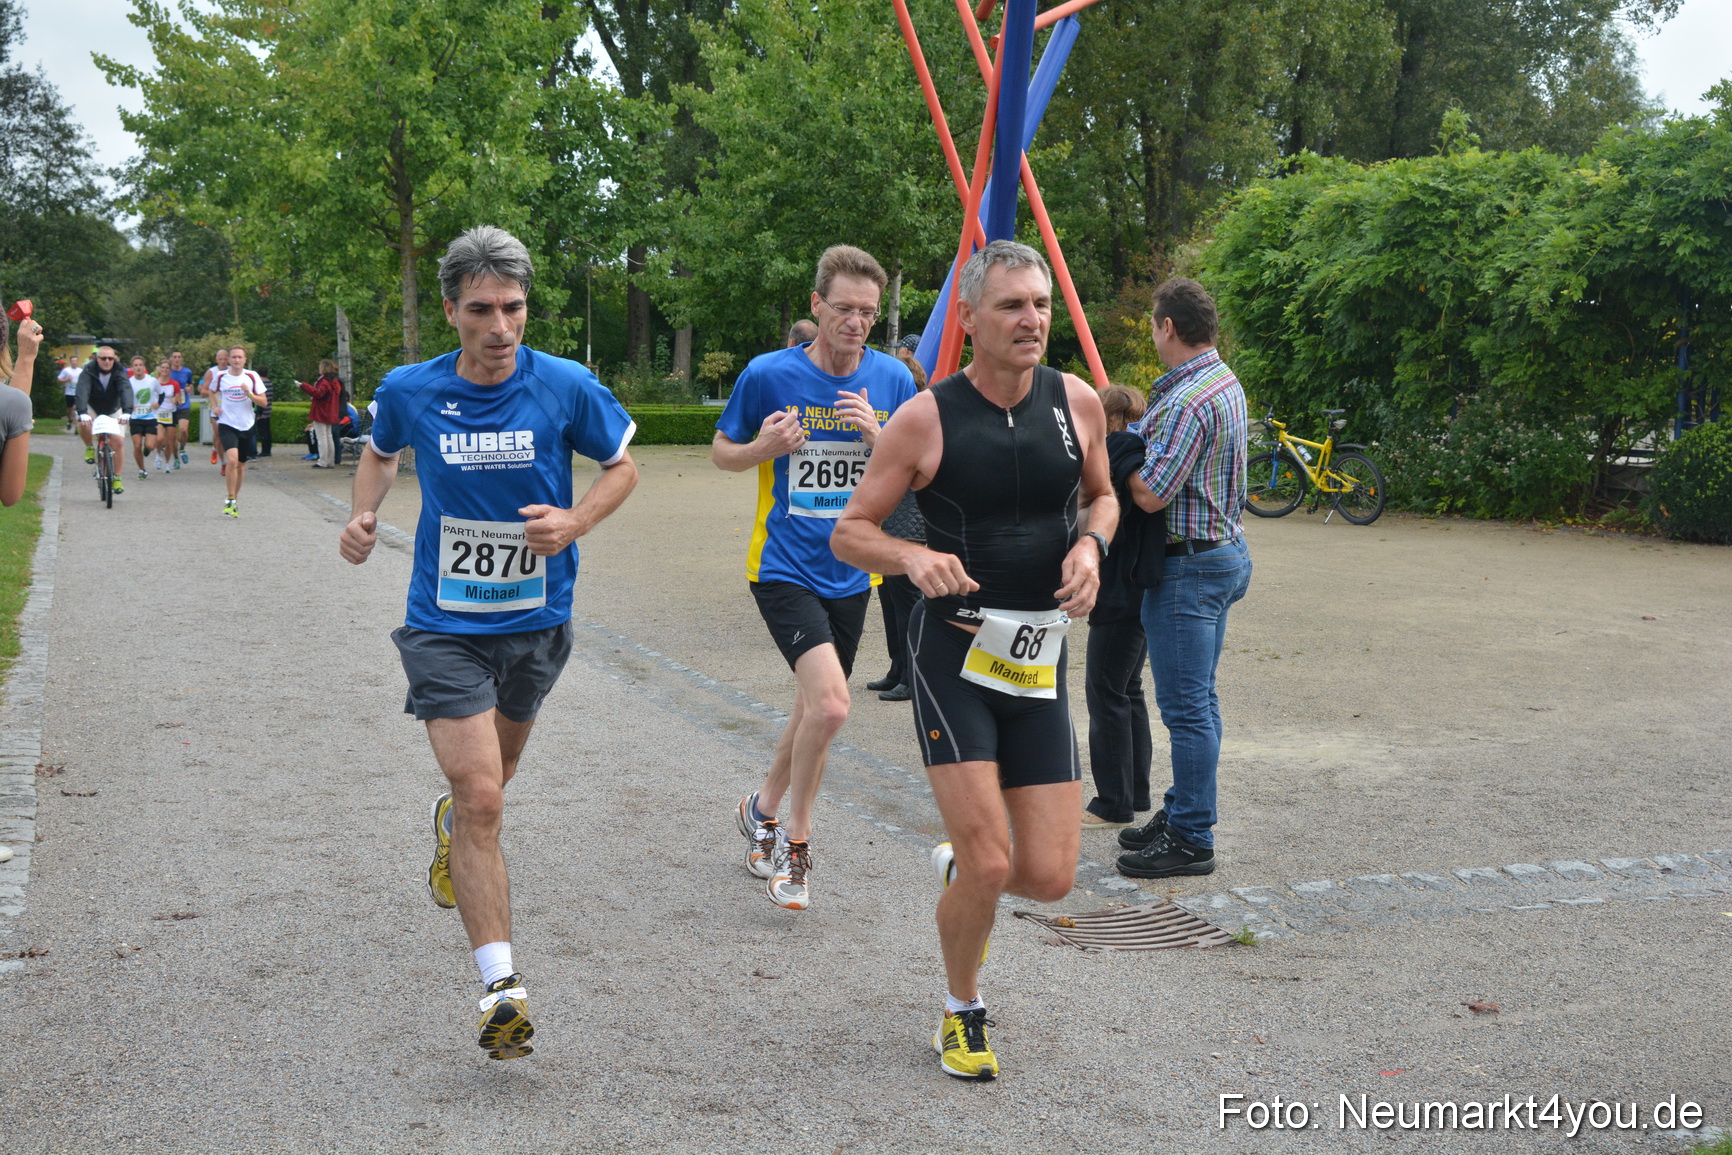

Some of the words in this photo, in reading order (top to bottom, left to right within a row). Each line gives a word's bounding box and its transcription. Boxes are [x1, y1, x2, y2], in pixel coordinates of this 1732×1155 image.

[440, 409, 461, 417] erima
[1052, 406, 1078, 461] 2XU
[439, 430, 535, 453] HUBER
[461, 452, 531, 462] TECHNOLOGY
[791, 448, 820, 457] PARTL
[822, 448, 861, 458] Neumarkt
[507, 462, 533, 470] Solutions
[798, 459, 866, 489] 2695
[814, 496, 848, 508] Martin
[443, 525, 478, 538] PARTL
[450, 540, 537, 578] 2870
[465, 585, 520, 600] Michael
[1009, 624, 1048, 661] 68
[989, 660, 1039, 685] Manfred
